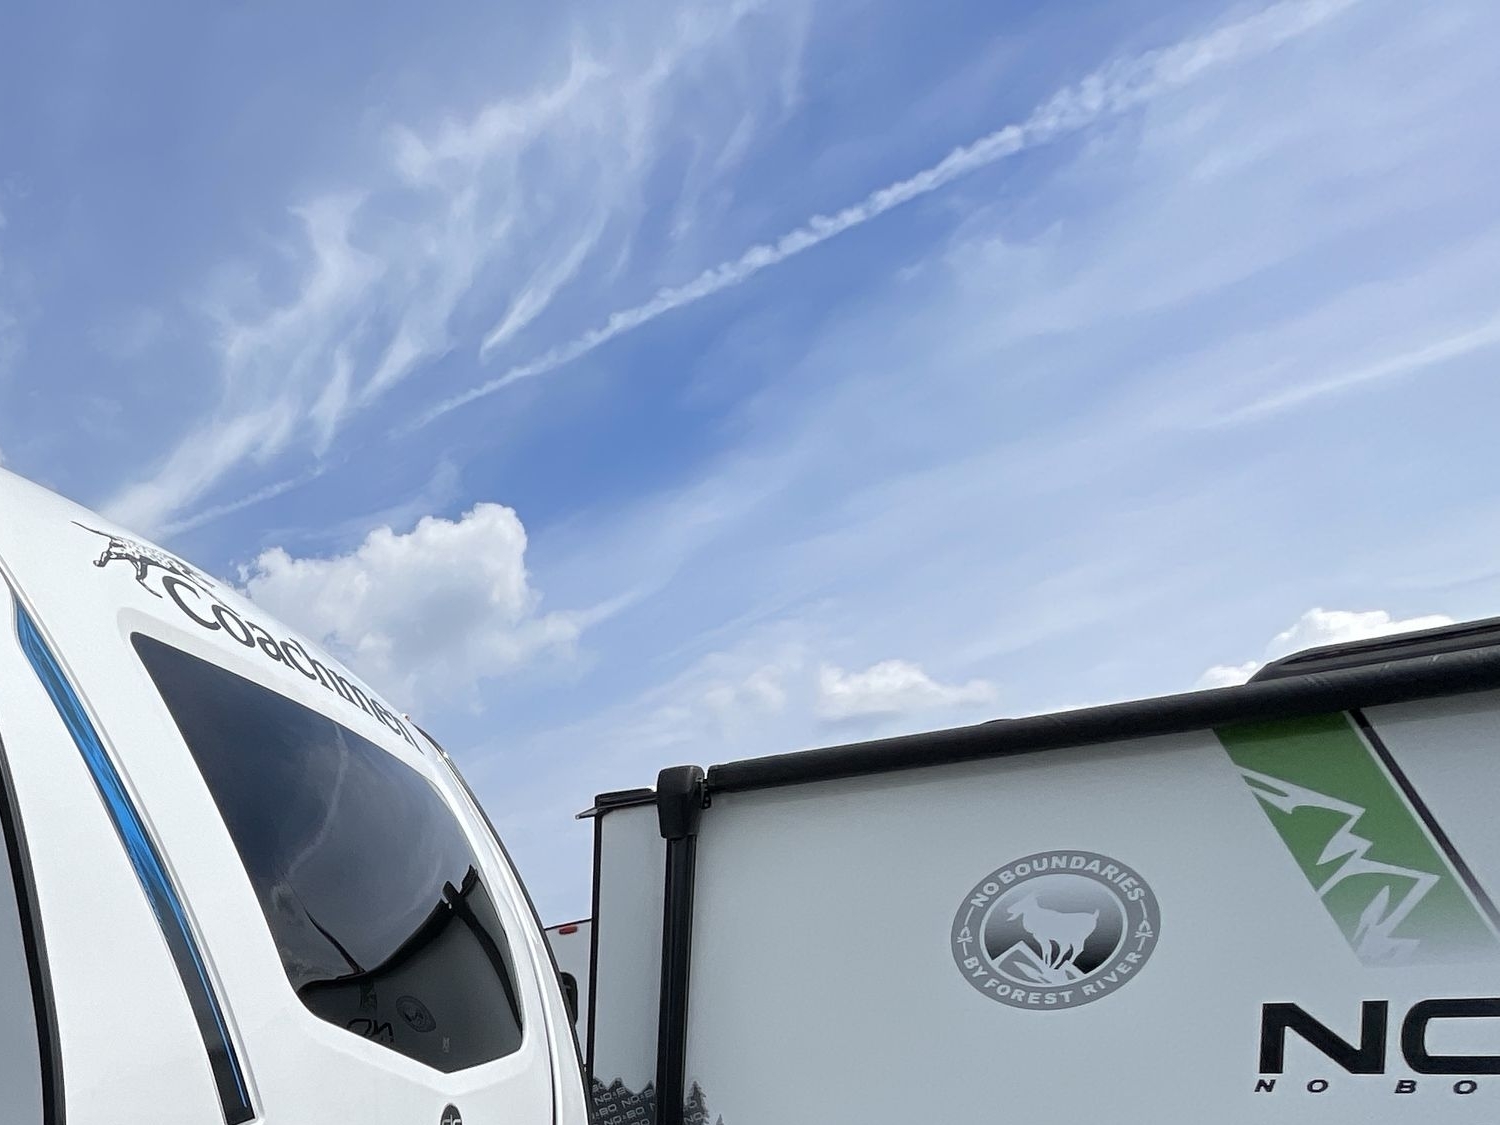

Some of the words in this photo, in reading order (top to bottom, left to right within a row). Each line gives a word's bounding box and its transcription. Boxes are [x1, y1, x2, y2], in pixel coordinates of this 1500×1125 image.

[163, 576, 424, 755] Coachmen
[963, 956, 988, 978] BY
[984, 979, 1074, 1005] FOREST
[1082, 951, 1142, 996] RIVER
